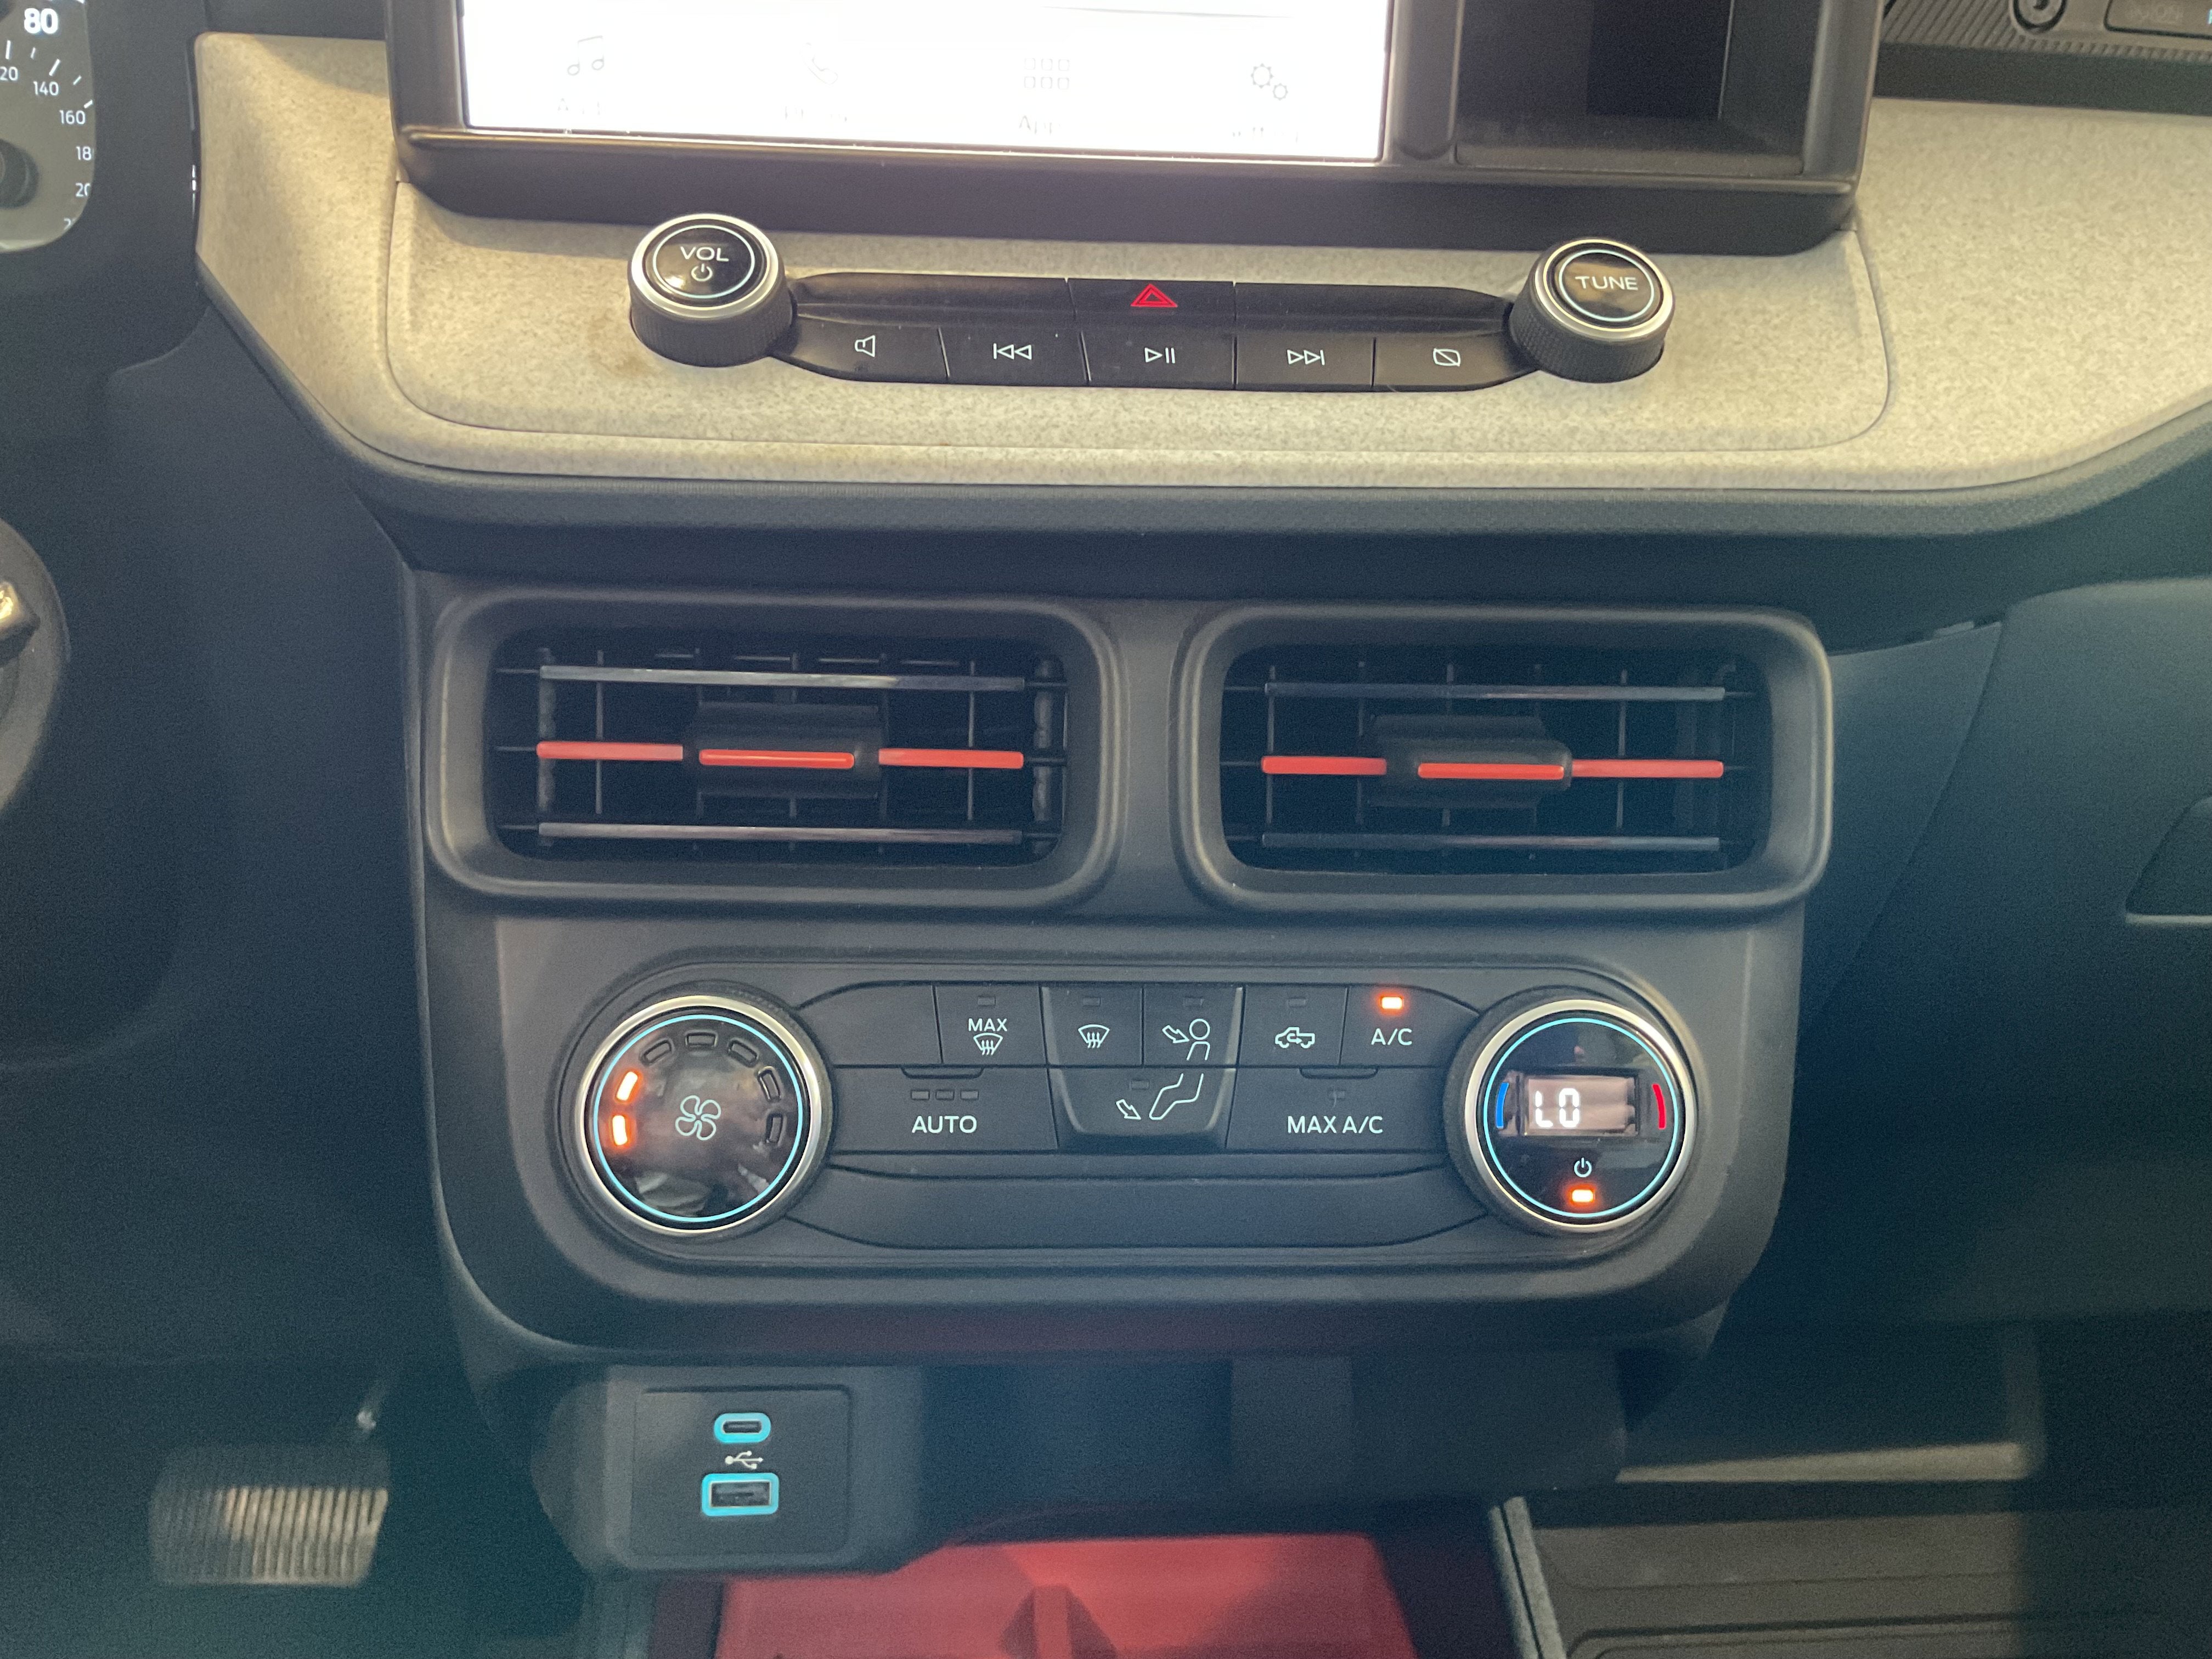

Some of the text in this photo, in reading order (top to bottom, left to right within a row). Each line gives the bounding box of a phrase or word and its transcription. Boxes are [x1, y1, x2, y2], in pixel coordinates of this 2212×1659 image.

[24, 8, 58, 34] 80
[0, 66, 18, 81] 20
[33, 81, 59, 96] 140
[59, 110, 86, 125] 160
[76, 146, 94, 160] 18
[680, 246, 729, 262] VOL
[1575, 276, 1638, 290] TUNE
[968, 1018, 1007, 1032] MAX
[1371, 1028, 1413, 1046] A/C
[911, 1115, 978, 1134] AUTO
[1287, 1115, 1383, 1135] MAX A/C
